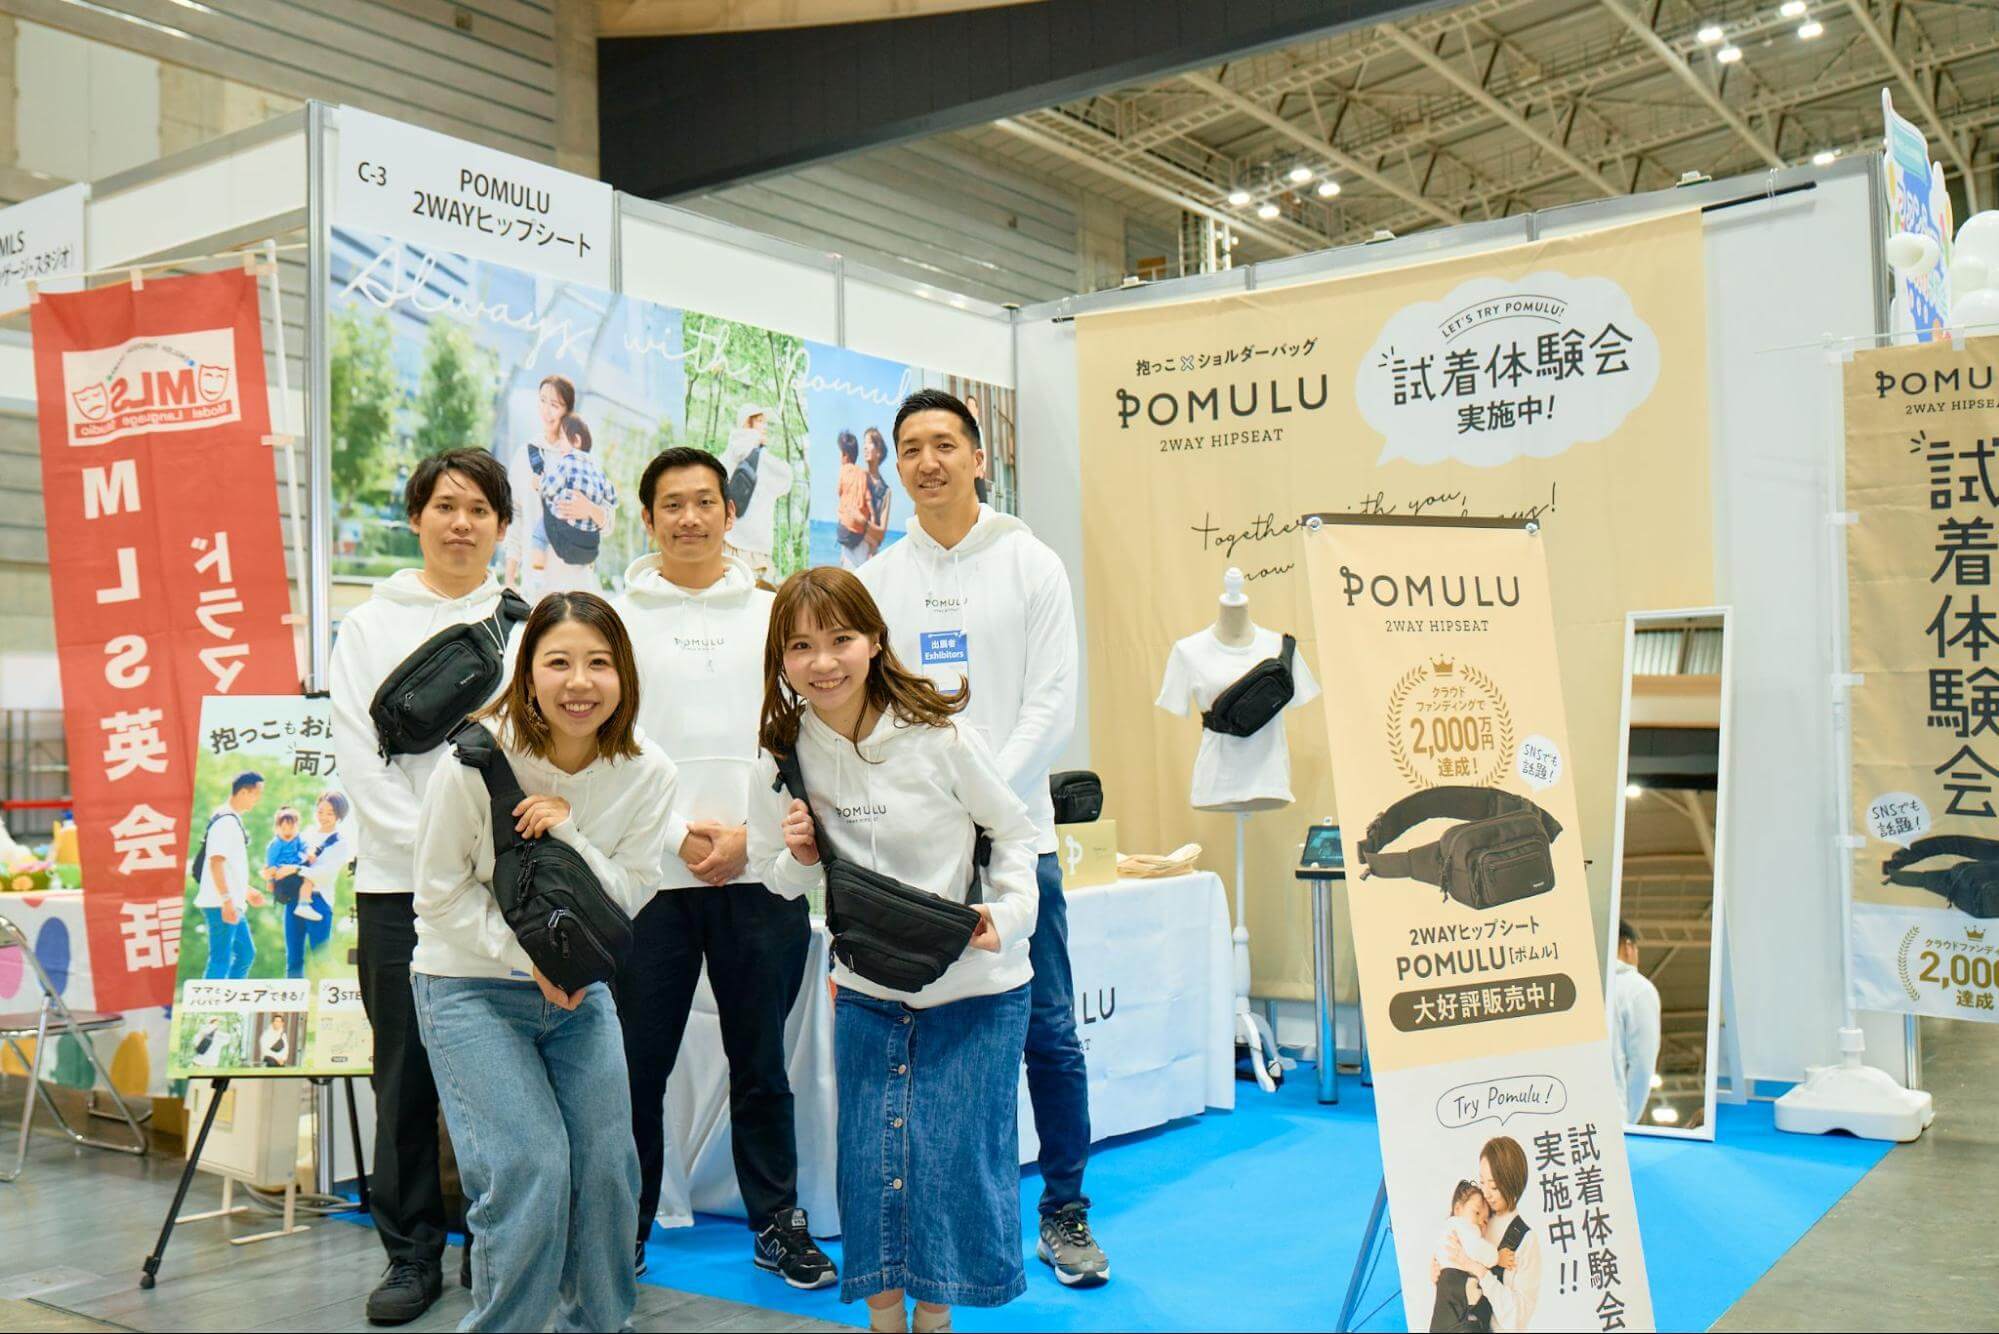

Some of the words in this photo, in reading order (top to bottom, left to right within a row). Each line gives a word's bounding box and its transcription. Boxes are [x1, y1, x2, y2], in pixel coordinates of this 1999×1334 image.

[357, 161, 387, 186] C-3
[460, 169, 551, 215] POMULU
[412, 190, 591, 258] 2WAYヒップシート
[338, 243, 594, 369] Always
[623, 316, 750, 375] with
[1442, 313, 1473, 338] LET'S
[1476, 304, 1500, 319] TRY
[1505, 301, 1565, 316] POMULU!
[1391, 322, 1634, 406] 試着体験会
[1115, 373, 1328, 429] POMULU
[1457, 394, 1556, 434] 実施中!
[1905, 401, 1947, 416] 2WAY
[1159, 436, 1205, 453] 2WAY
[1210, 428, 1284, 448] HIPSEAT
[1339, 565, 1520, 607] POMULU
[1385, 620, 1424, 633] 2WAY
[1429, 619, 1490, 633] HIPSEAT
[1925, 437, 1999, 818] 試着体験会
[1409, 915, 1540, 946] 2WAYヒップシート
[1412, 982, 1557, 1025] 大好評販売中!
[1453, 1095, 1479, 1120] Try
[1567, 1122, 1626, 1332] 試着体験会
